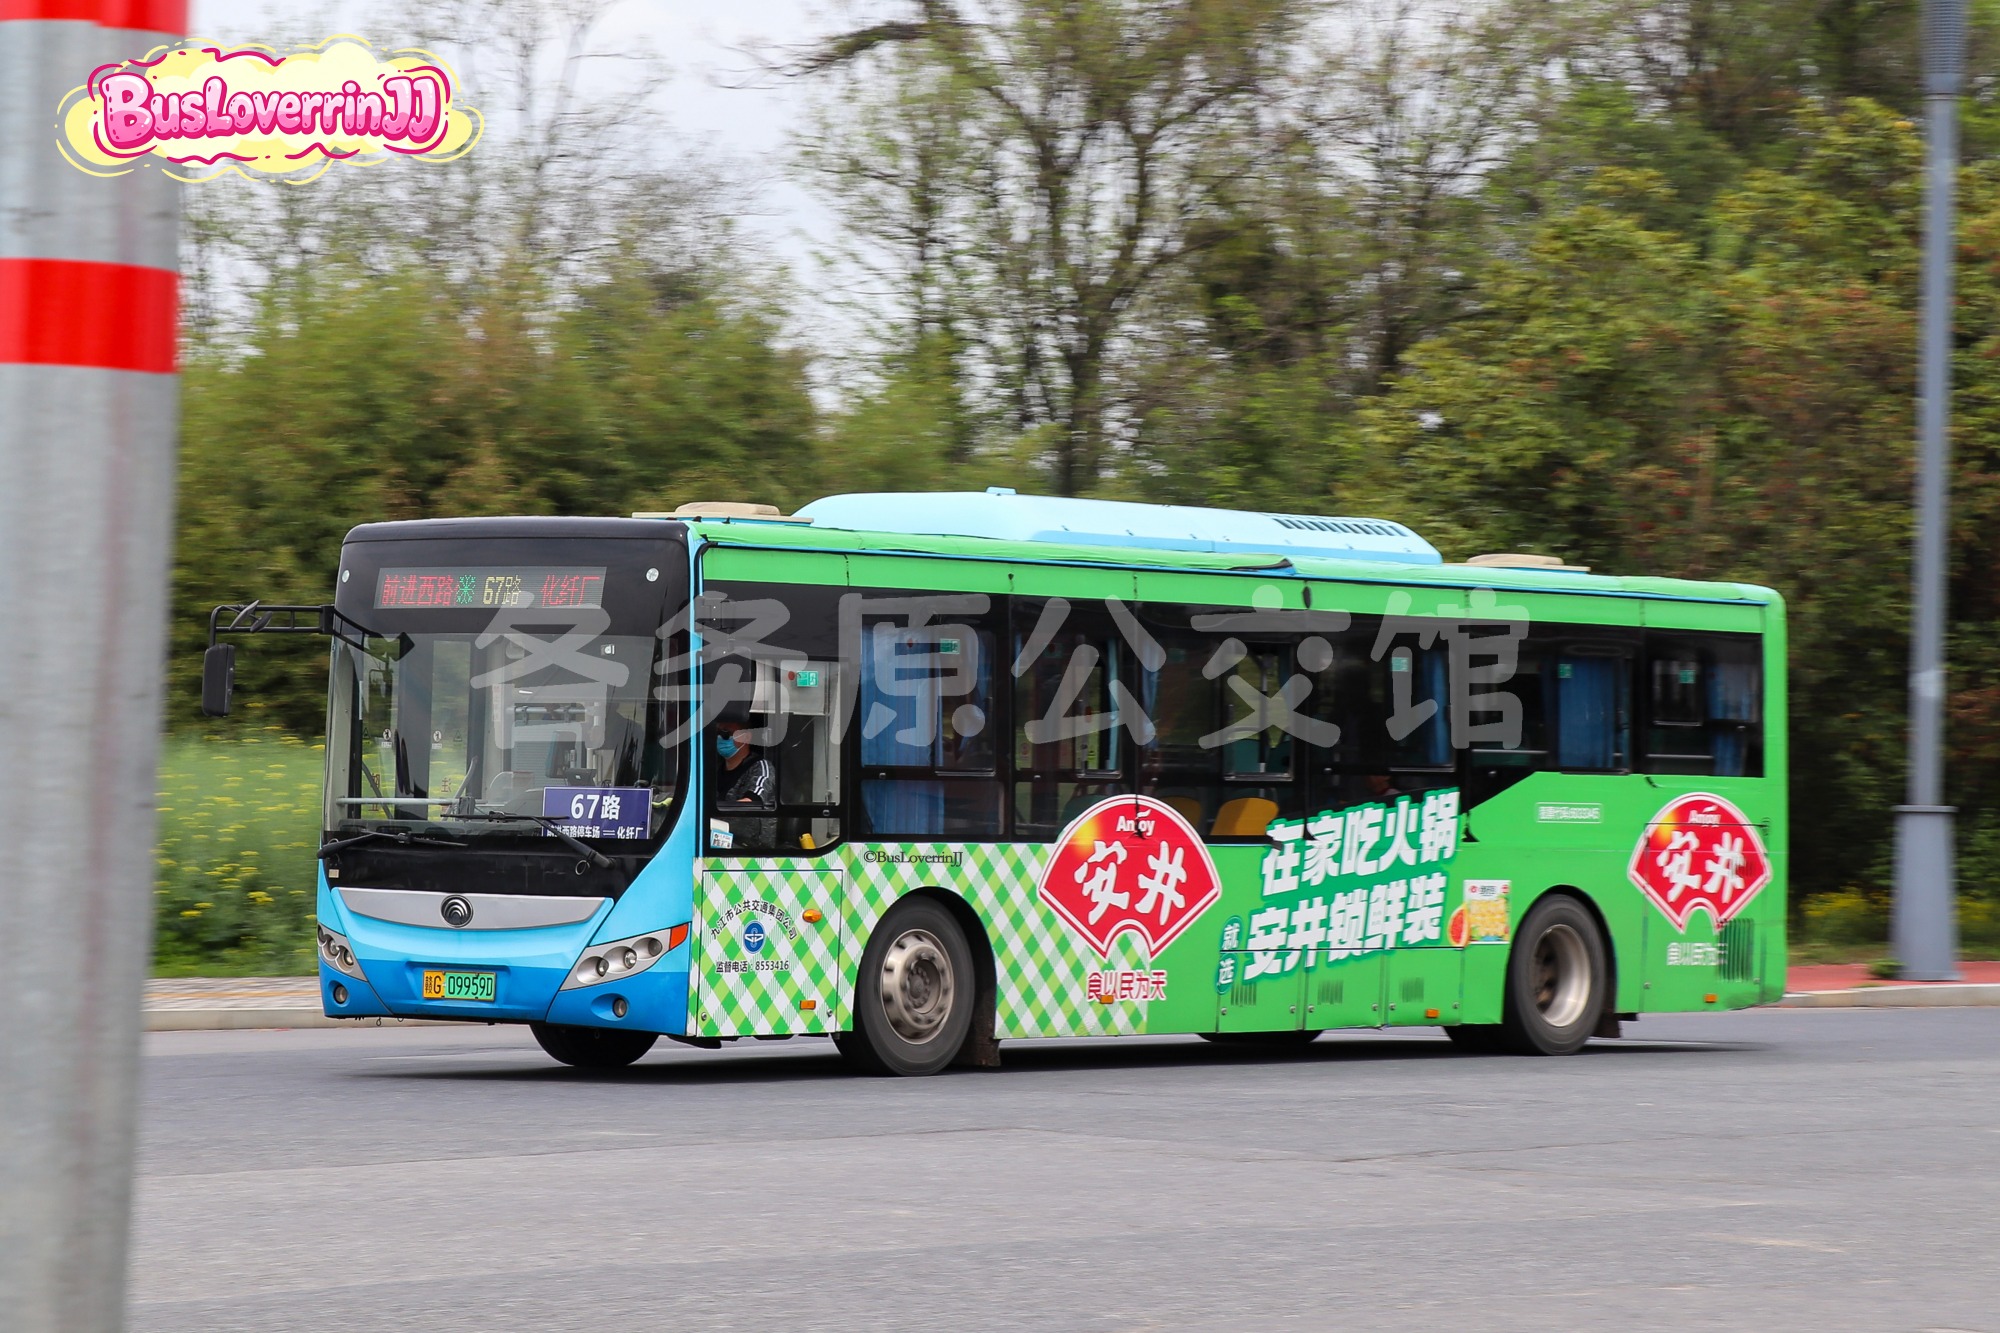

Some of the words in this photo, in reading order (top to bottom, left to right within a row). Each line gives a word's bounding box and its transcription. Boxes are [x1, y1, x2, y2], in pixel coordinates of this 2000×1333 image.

[381, 574, 459, 606] 前进西路
[482, 575, 522, 607] 67路
[541, 574, 600, 607] 化纤厂
[571, 794, 621, 820] 67路
[616, 826, 644, 840] 化纤厂
[1261, 791, 1461, 897] 在家吃火锅
[1073, 839, 1188, 926] 安井
[710, 899, 798, 941] 九江市公共交通集团公司
[1243, 871, 1448, 982] 安井锁鲜装
[1087, 970, 1167, 1000] 食以民为天
